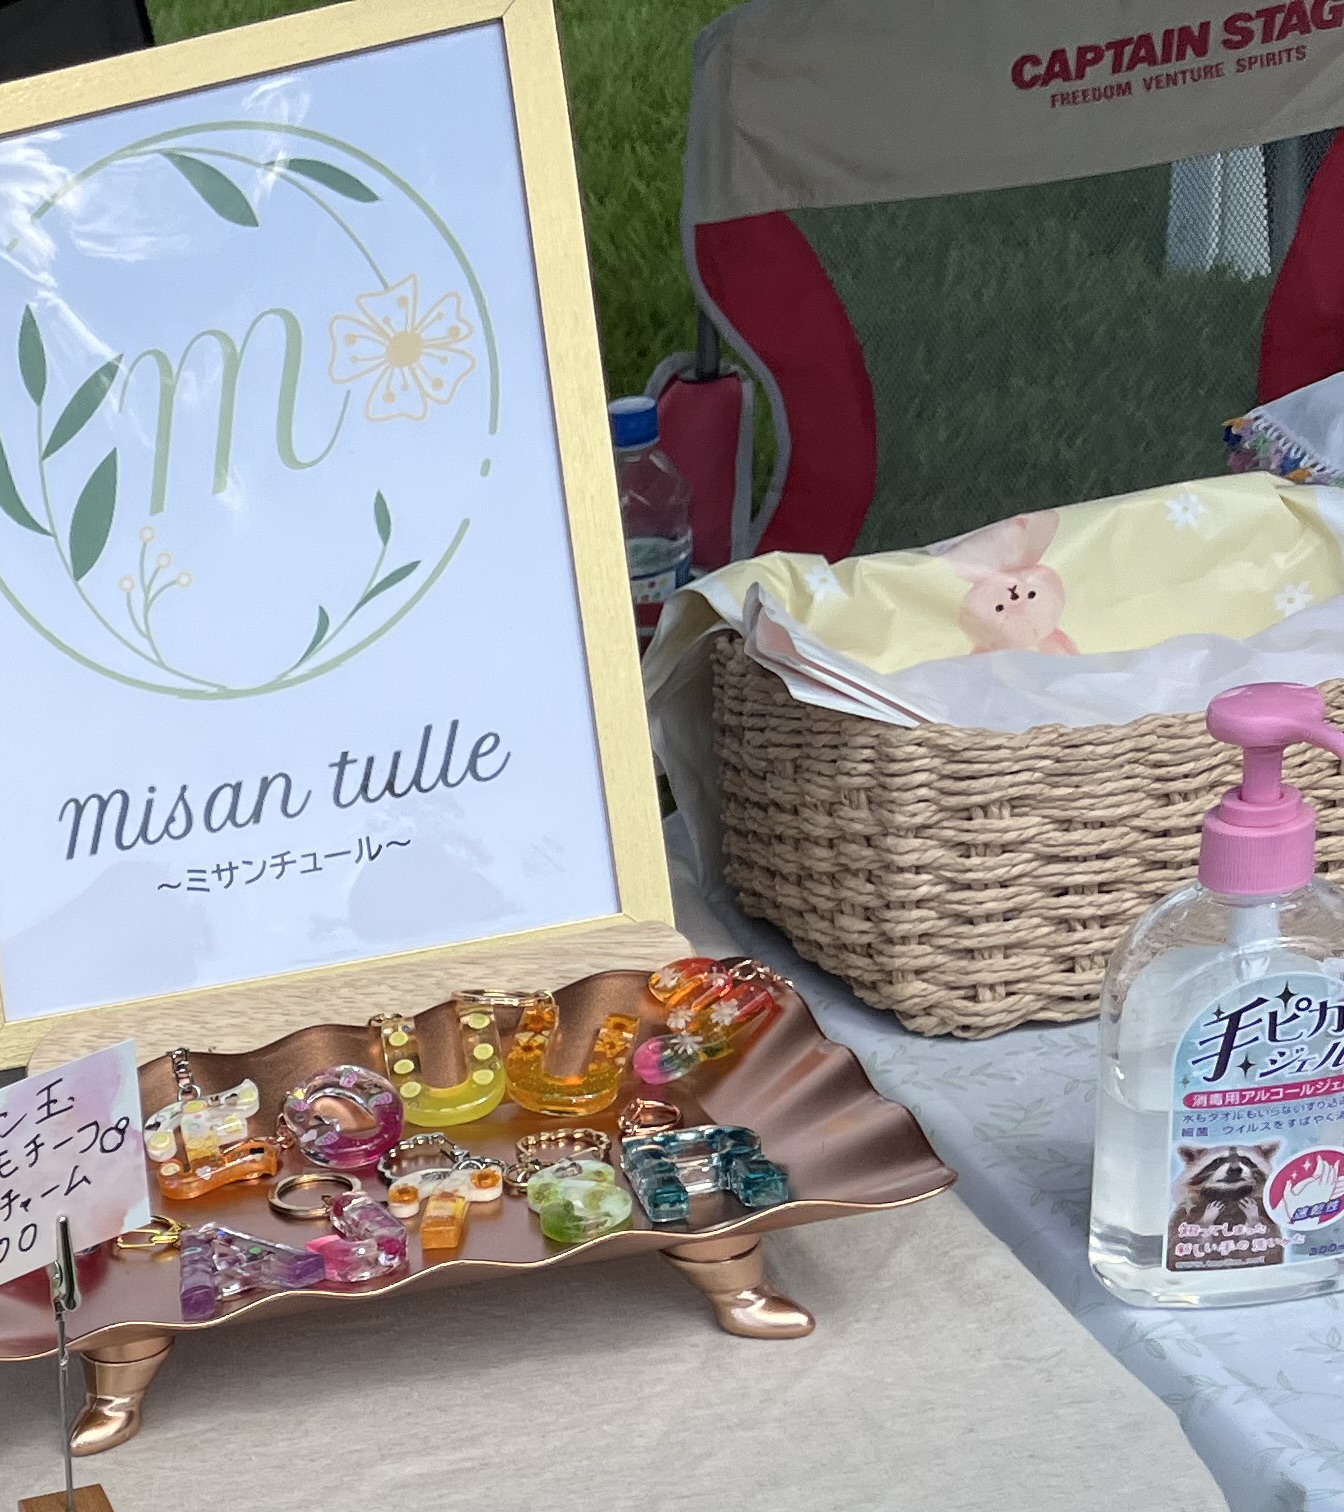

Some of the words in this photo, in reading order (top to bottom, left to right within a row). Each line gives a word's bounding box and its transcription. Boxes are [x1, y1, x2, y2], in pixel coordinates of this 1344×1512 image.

[1012, 21, 1211, 90] CAPTAIN
[1222, 0, 1344, 51] STAG
[1050, 82, 1133, 109] FREEDOM
[1143, 61, 1226, 93] VENTURE
[1235, 44, 1308, 75] SPIRITS
[58, 769, 312, 862] misan
[329, 717, 512, 806] tulle
